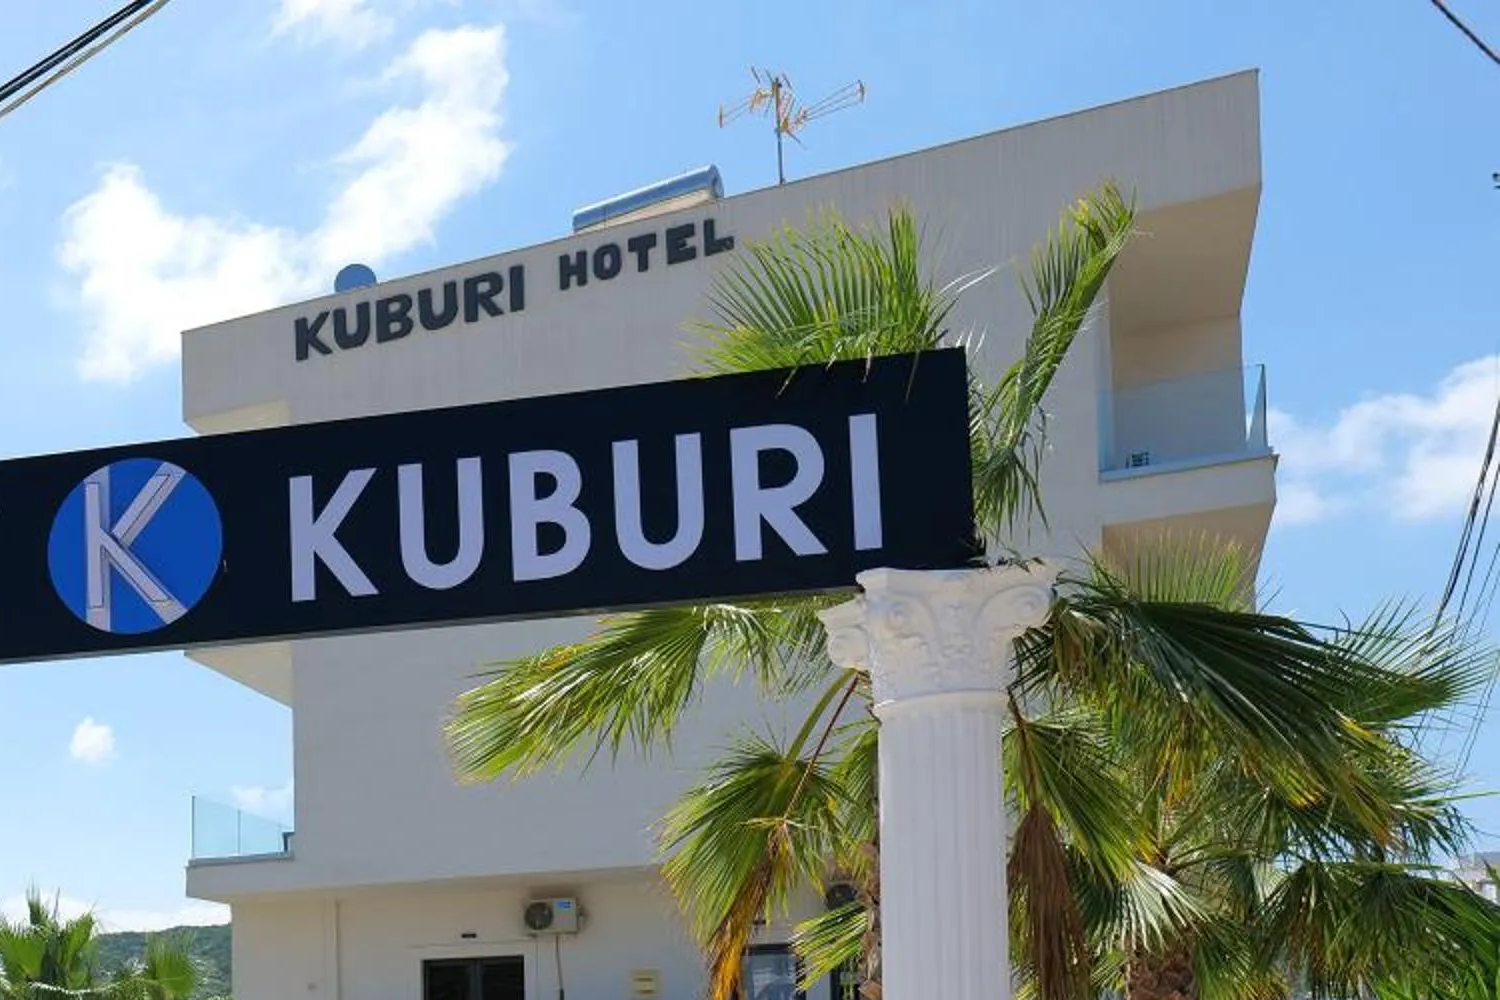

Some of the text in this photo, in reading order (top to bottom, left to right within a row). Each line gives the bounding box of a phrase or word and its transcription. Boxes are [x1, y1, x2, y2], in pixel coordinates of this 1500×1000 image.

[294, 218, 736, 362] KUBURI HOTEL
[83, 461, 189, 632] K
[289, 413, 883, 602] KUBURI
